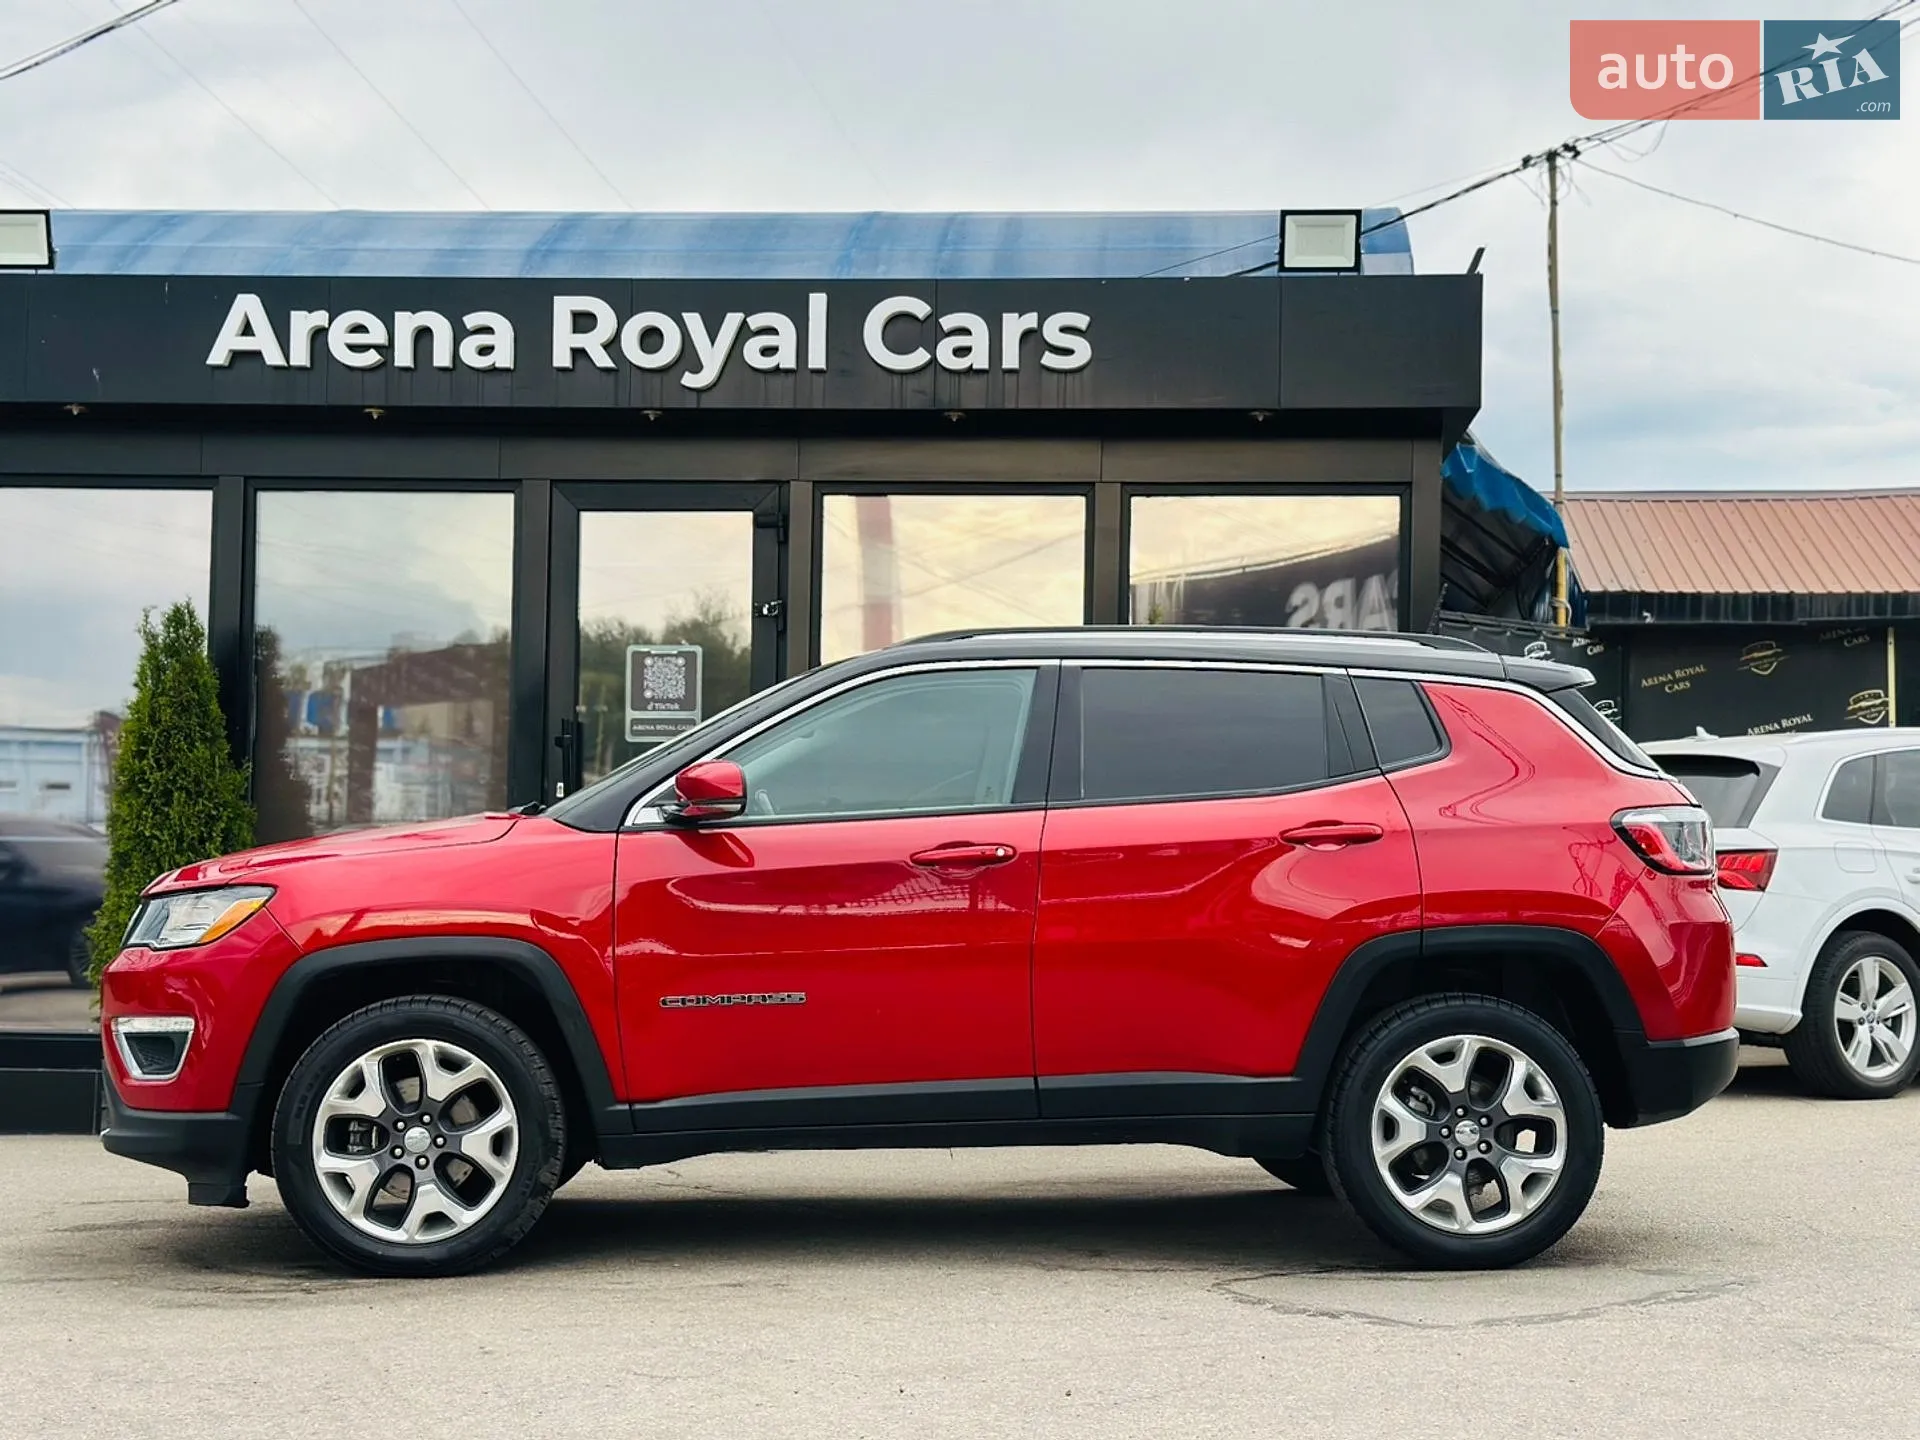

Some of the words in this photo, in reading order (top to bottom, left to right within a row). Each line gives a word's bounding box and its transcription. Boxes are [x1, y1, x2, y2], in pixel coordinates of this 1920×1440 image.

[205, 293, 515, 371] Arena
[552, 292, 828, 391] Royal
[862, 295, 1093, 374] Cars
[1641, 672, 1674, 688] ARENA
[1674, 664, 1707, 679] ROYAL
[1664, 681, 1691, 694] CARS
[1747, 722, 1780, 736] ARENA
[1781, 713, 1813, 728] ROYAL
[659, 992, 806, 1007] COMPASS
